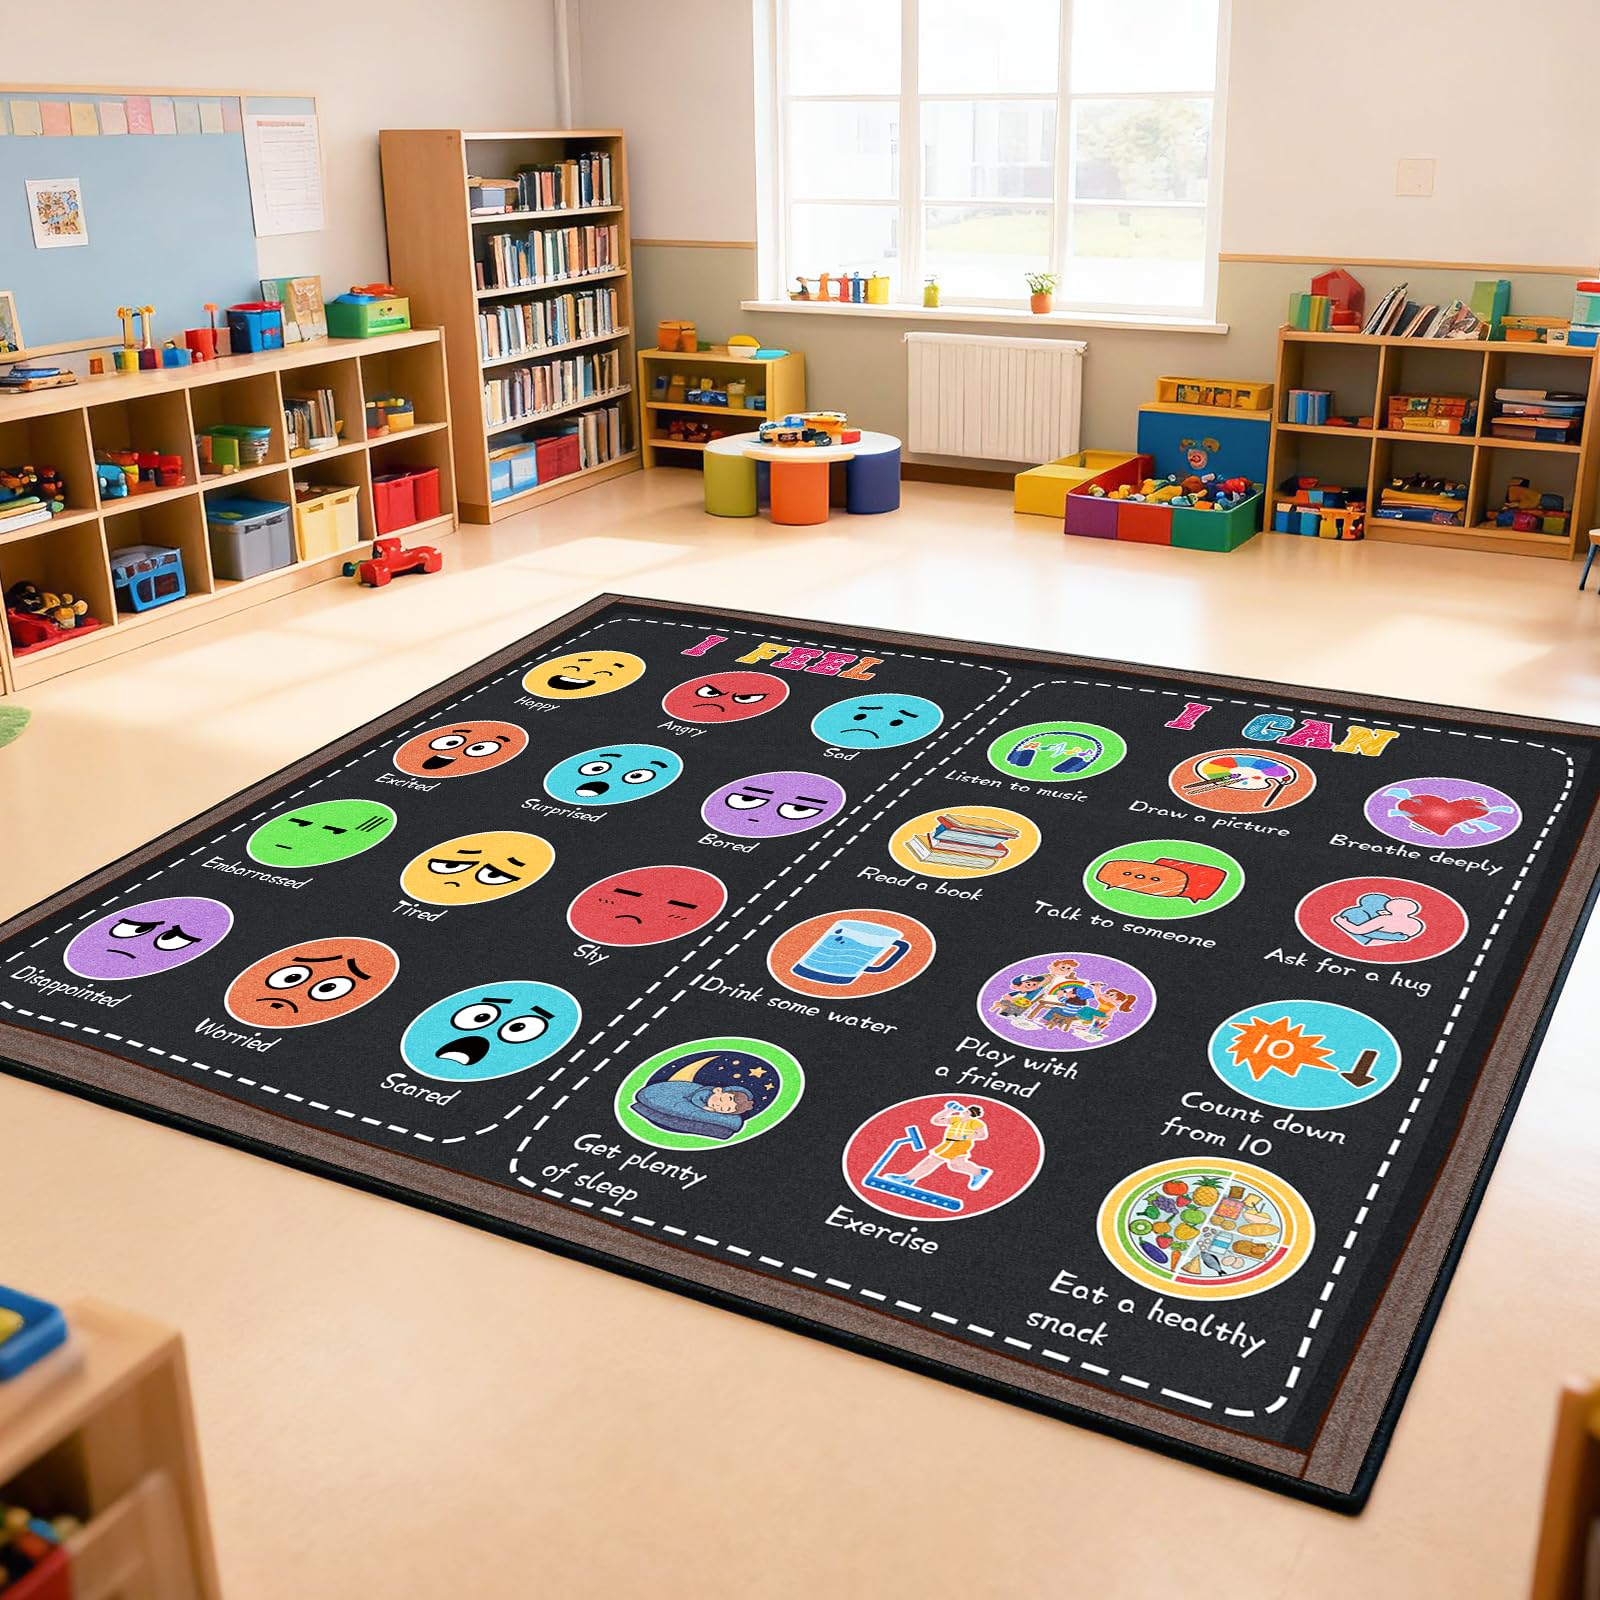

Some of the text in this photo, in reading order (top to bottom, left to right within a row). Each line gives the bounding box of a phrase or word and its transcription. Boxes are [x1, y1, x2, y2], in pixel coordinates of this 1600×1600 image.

[680, 634, 885, 681] I FEEL
[513, 695, 561, 713] Happy
[656, 720, 708, 738] Angry
[1163, 702, 1400, 757] I CAN
[822, 747, 861, 761] Sad
[374, 772, 442, 792] Excited
[943, 769, 1088, 803] Listen to music
[520, 798, 608, 823] Surprised
[1128, 799, 1291, 837] Draw a picture
[697, 832, 761, 854] Bored
[1328, 833, 1504, 877] Breathe deeply
[200, 855, 314, 890] Embarrassed
[855, 865, 984, 901] Read a book
[391, 899, 449, 922] Tired
[1034, 899, 1217, 949] Talk to someone
[573, 943, 610, 966] Shy
[1263, 947, 1432, 998] Ask for a hug
[9, 965, 133, 1008] Disappointed
[699, 975, 898, 1035] Drink some water
[194, 1017, 283, 1053] Worried
[1253, 1034, 1295, 1060] 10
[955, 1035, 1078, 1080] Play with
[380, 1072, 462, 1106] Scared
[934, 1066, 1042, 1099] a friend
[1160, 1116, 1273, 1156] from 10
[1181, 1091, 1346, 1145] Count down
[573, 1133, 708, 1190] Get plenty
[541, 1162, 638, 1207] of sleep
[824, 1204, 939, 1255] Exercise
[1026, 1312, 1109, 1347] snack
[1048, 1269, 1267, 1359] Eat a healthy
